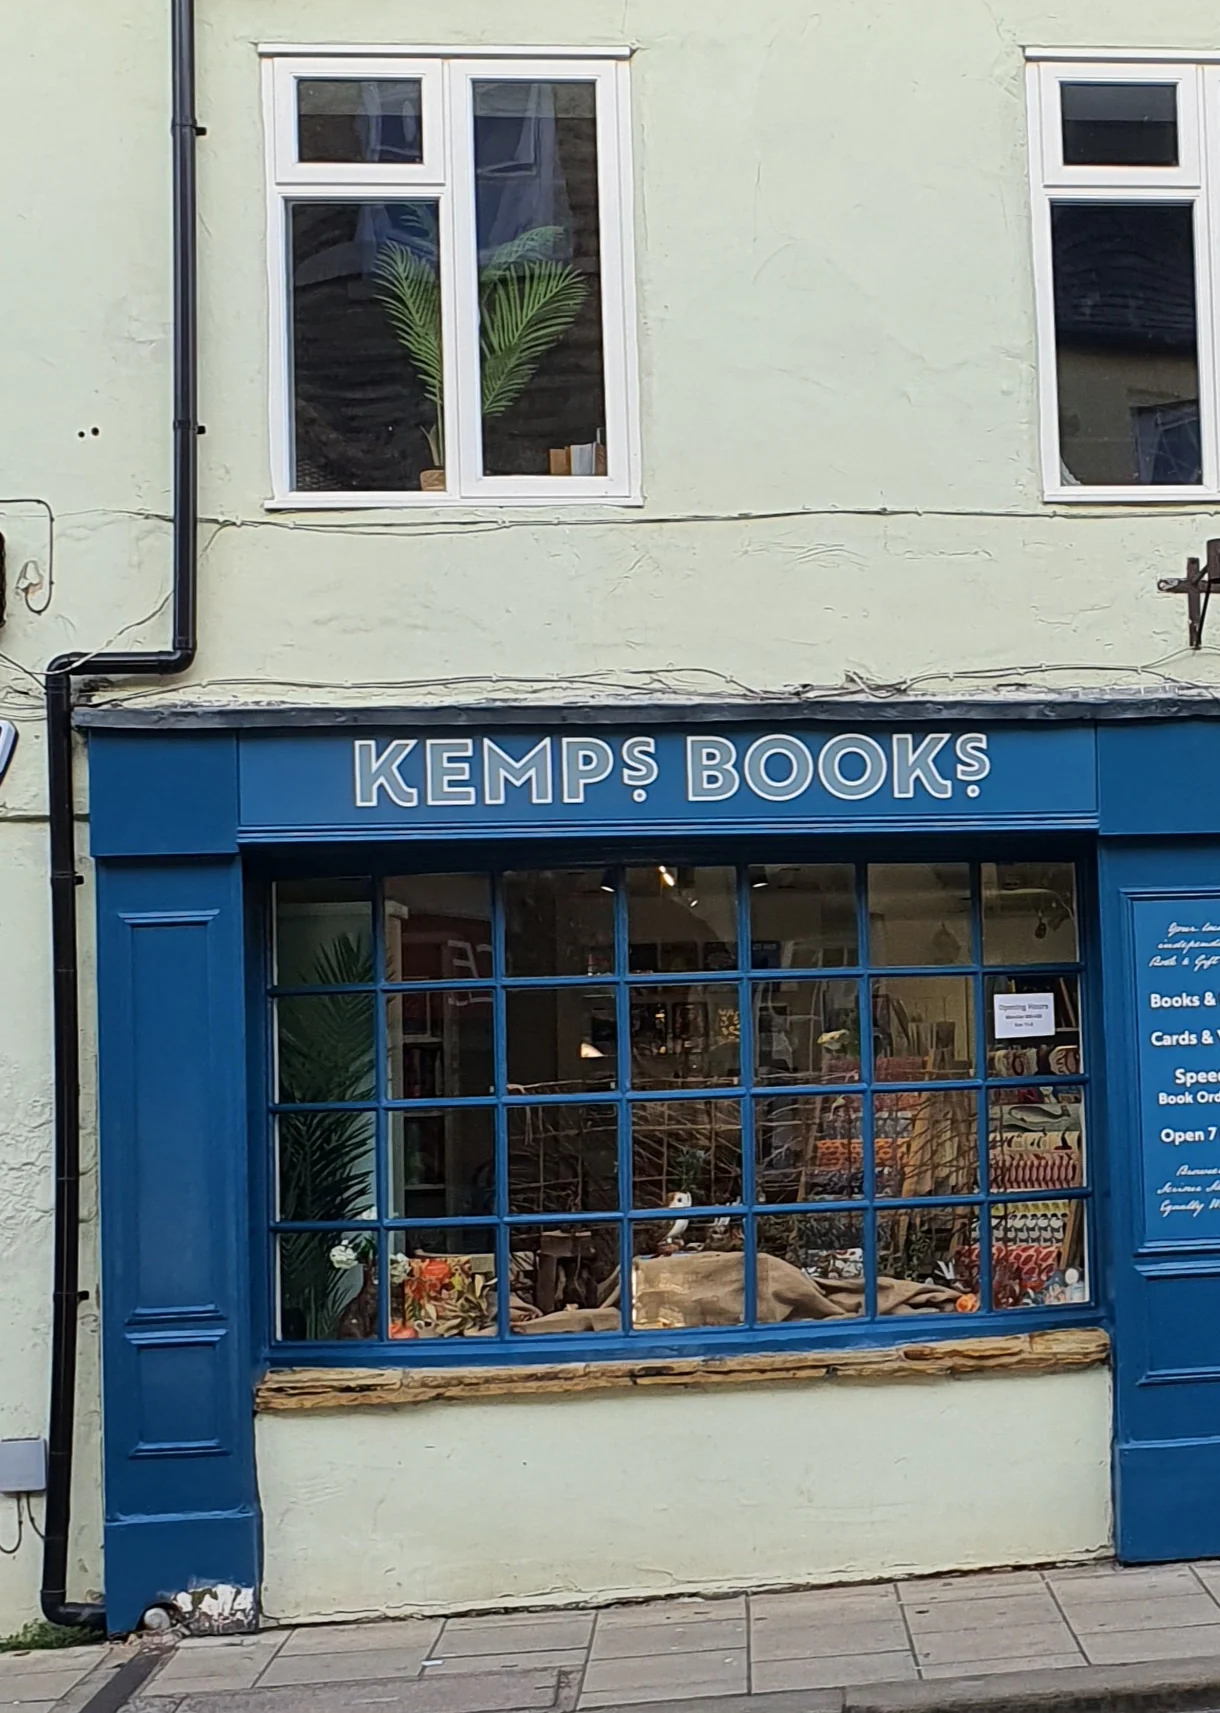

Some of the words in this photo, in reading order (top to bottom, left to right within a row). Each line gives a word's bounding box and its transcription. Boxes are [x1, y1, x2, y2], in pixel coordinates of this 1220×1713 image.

[354, 736, 659, 808] KEMPS
[686, 733, 990, 802] BOOKS
[1150, 992, 1201, 1008] Books
[1203, 991, 1217, 1007] &
[1150, 1030, 1198, 1047] Cards
[1201, 1029, 1214, 1045] &
[1158, 1091, 1194, 1105] Book
[1160, 1128, 1205, 1146] Open
[1207, 1126, 1218, 1141] 7
